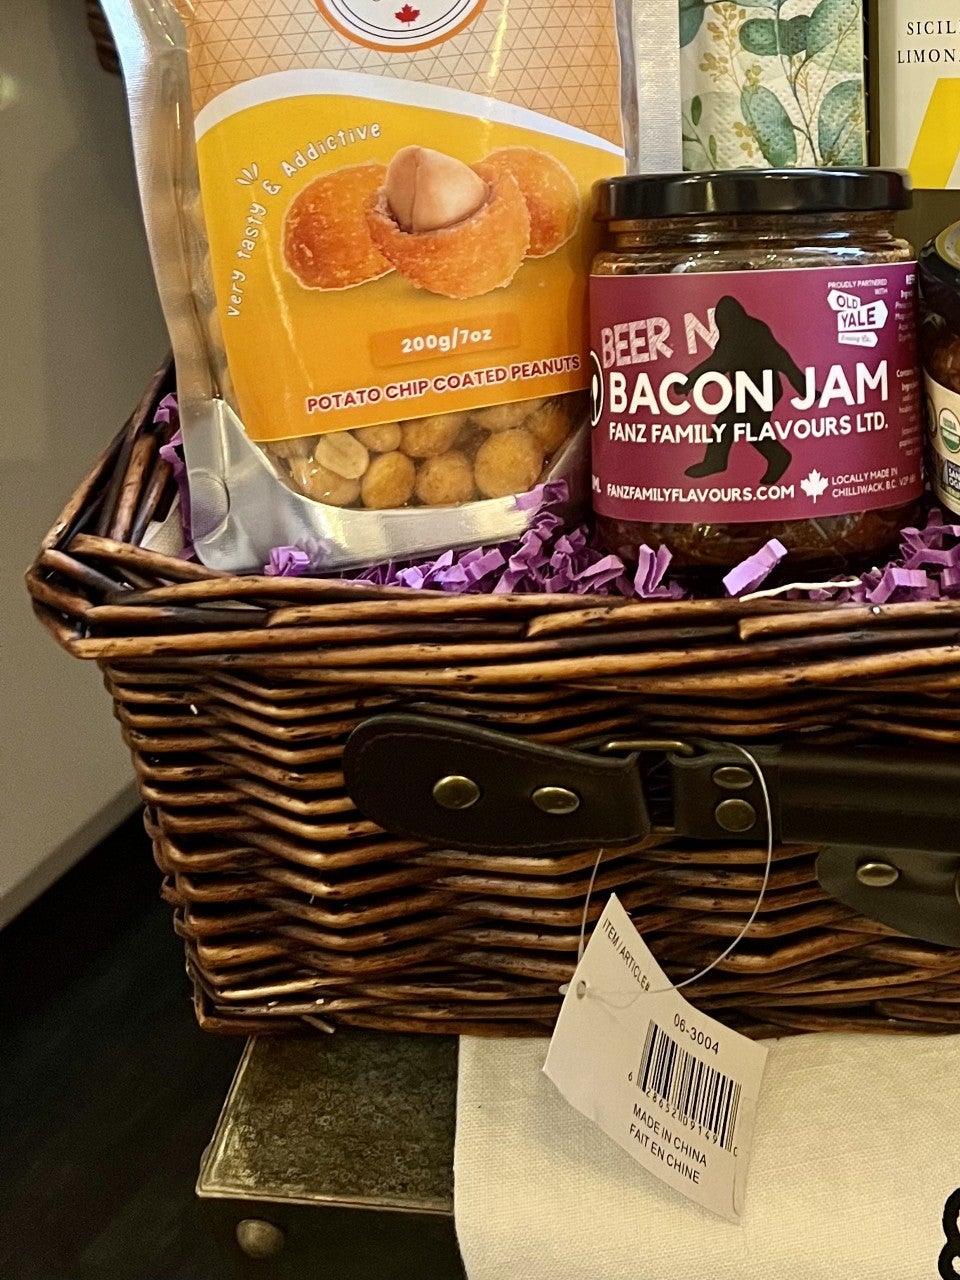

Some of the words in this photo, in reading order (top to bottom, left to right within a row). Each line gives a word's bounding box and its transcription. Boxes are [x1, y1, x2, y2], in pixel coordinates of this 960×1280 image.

[237, 202, 268, 260] tasty
[281, 122, 382, 178] Addictive
[836, 295, 858, 310] OLD
[841, 306, 876, 328] YALE
[400, 326, 493, 353] 200g/7oz
[601, 316, 674, 369] BEER
[683, 307, 721, 355] N
[307, 387, 382, 412] POTATO
[385, 379, 430, 400] CHIP
[432, 367, 508, 392] COATED
[511, 354, 581, 380] PEANUTS
[609, 369, 774, 416] BACON
[790, 360, 889, 411] JAM
[609, 422, 647, 443] FANZ
[651, 422, 727, 444] FAMILY
[733, 415, 852, 443] FLAVOURS
[856, 410, 889, 434] LTD.
[607, 483, 795, 503] FANZFAMILYFLAVOURS.COM
[831, 472, 869, 486] LOCALLY
[869, 468, 890, 480] MADE
[890, 467, 898, 476] IN
[602, 917, 621, 948] ITEM
[673, 1012, 720, 1055] 06-3004
[629, 1123, 650, 1148] FAIT
[650, 1141, 665, 1161] EN
[666, 1153, 701, 1185] CHINE
[633, 1103, 661, 1136] MADE
[661, 1127, 673, 1144] IN
[673, 1136, 707, 1168] CHINA
